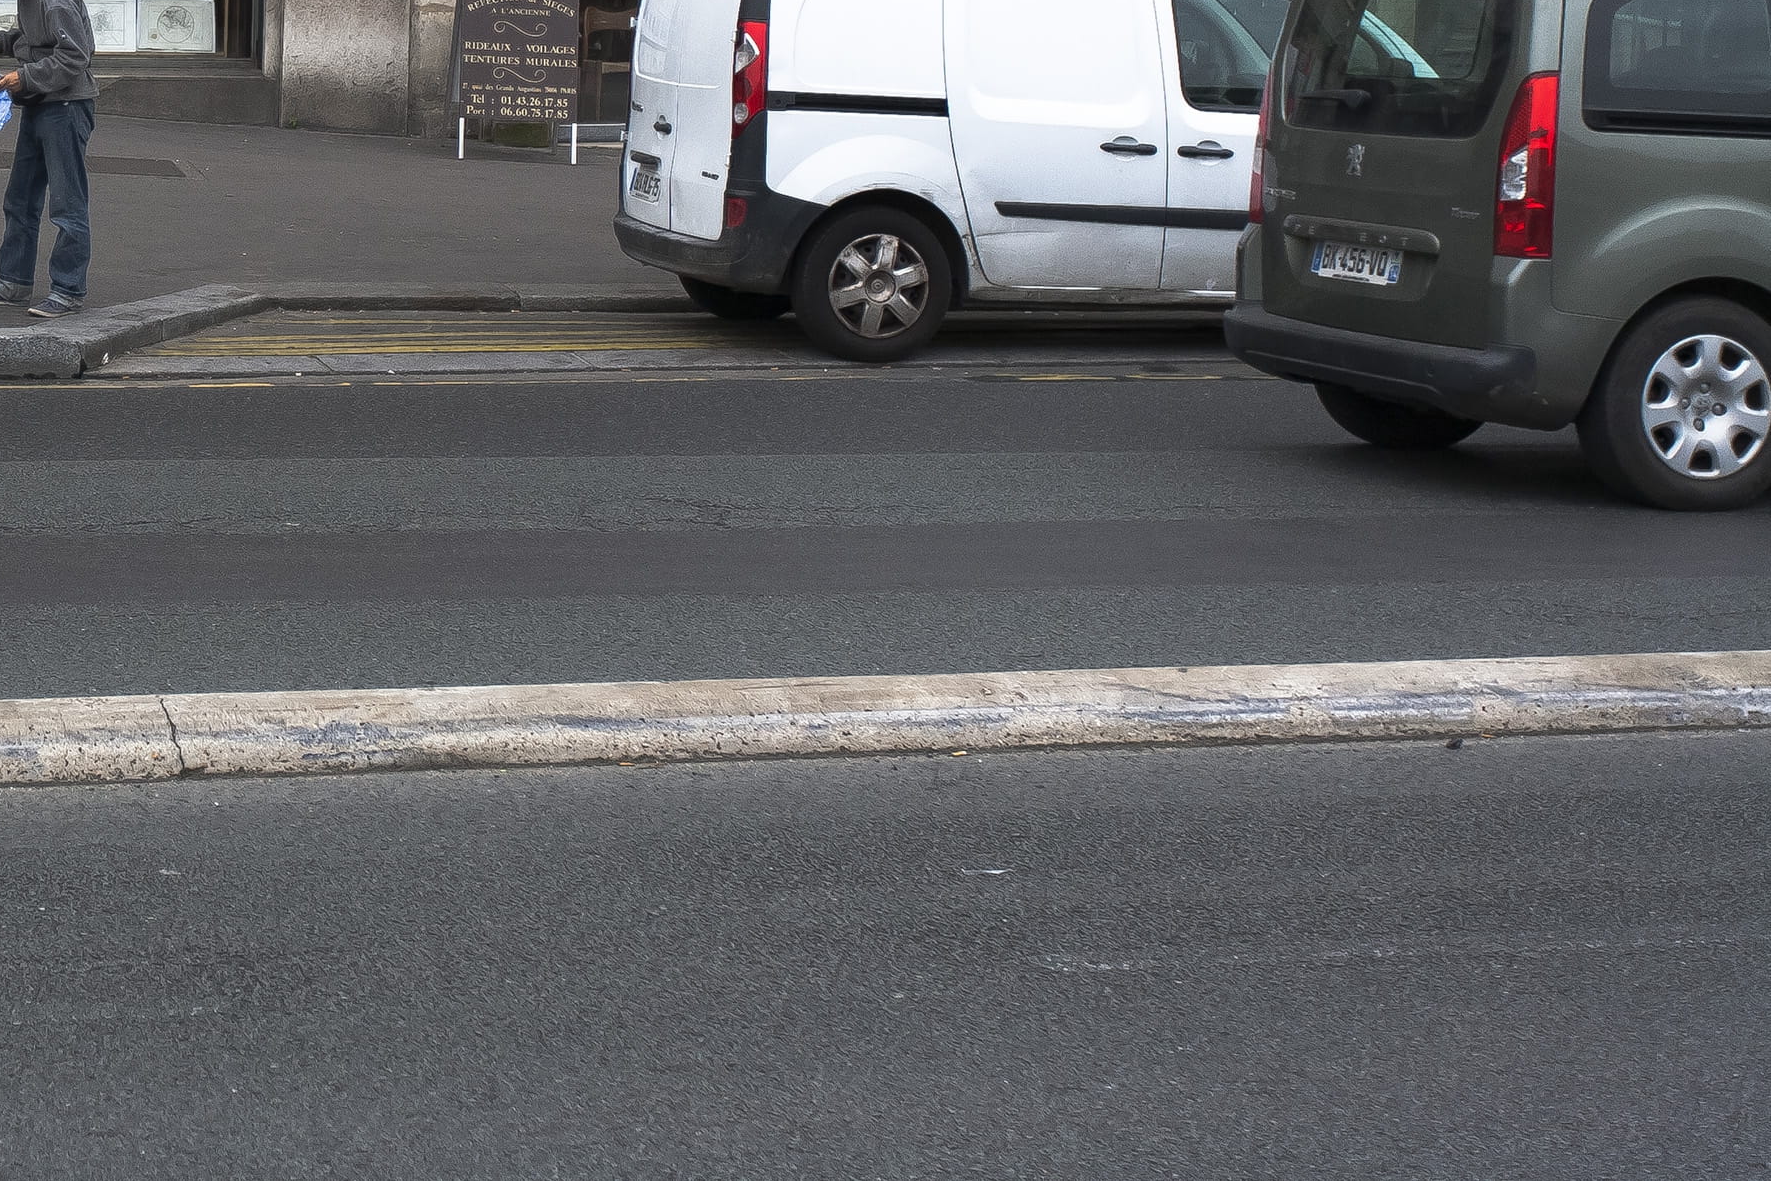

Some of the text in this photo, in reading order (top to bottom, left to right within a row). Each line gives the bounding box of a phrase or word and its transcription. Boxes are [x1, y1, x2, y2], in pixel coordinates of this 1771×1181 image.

[501, 7, 551, 17] L'ANCIENNE
[464, 41, 512, 52] RIDEAUX
[526, 44, 576, 55] VOILAGES
[463, 54, 577, 68] TENTURES MURALES
[466, 105, 486, 115] Port
